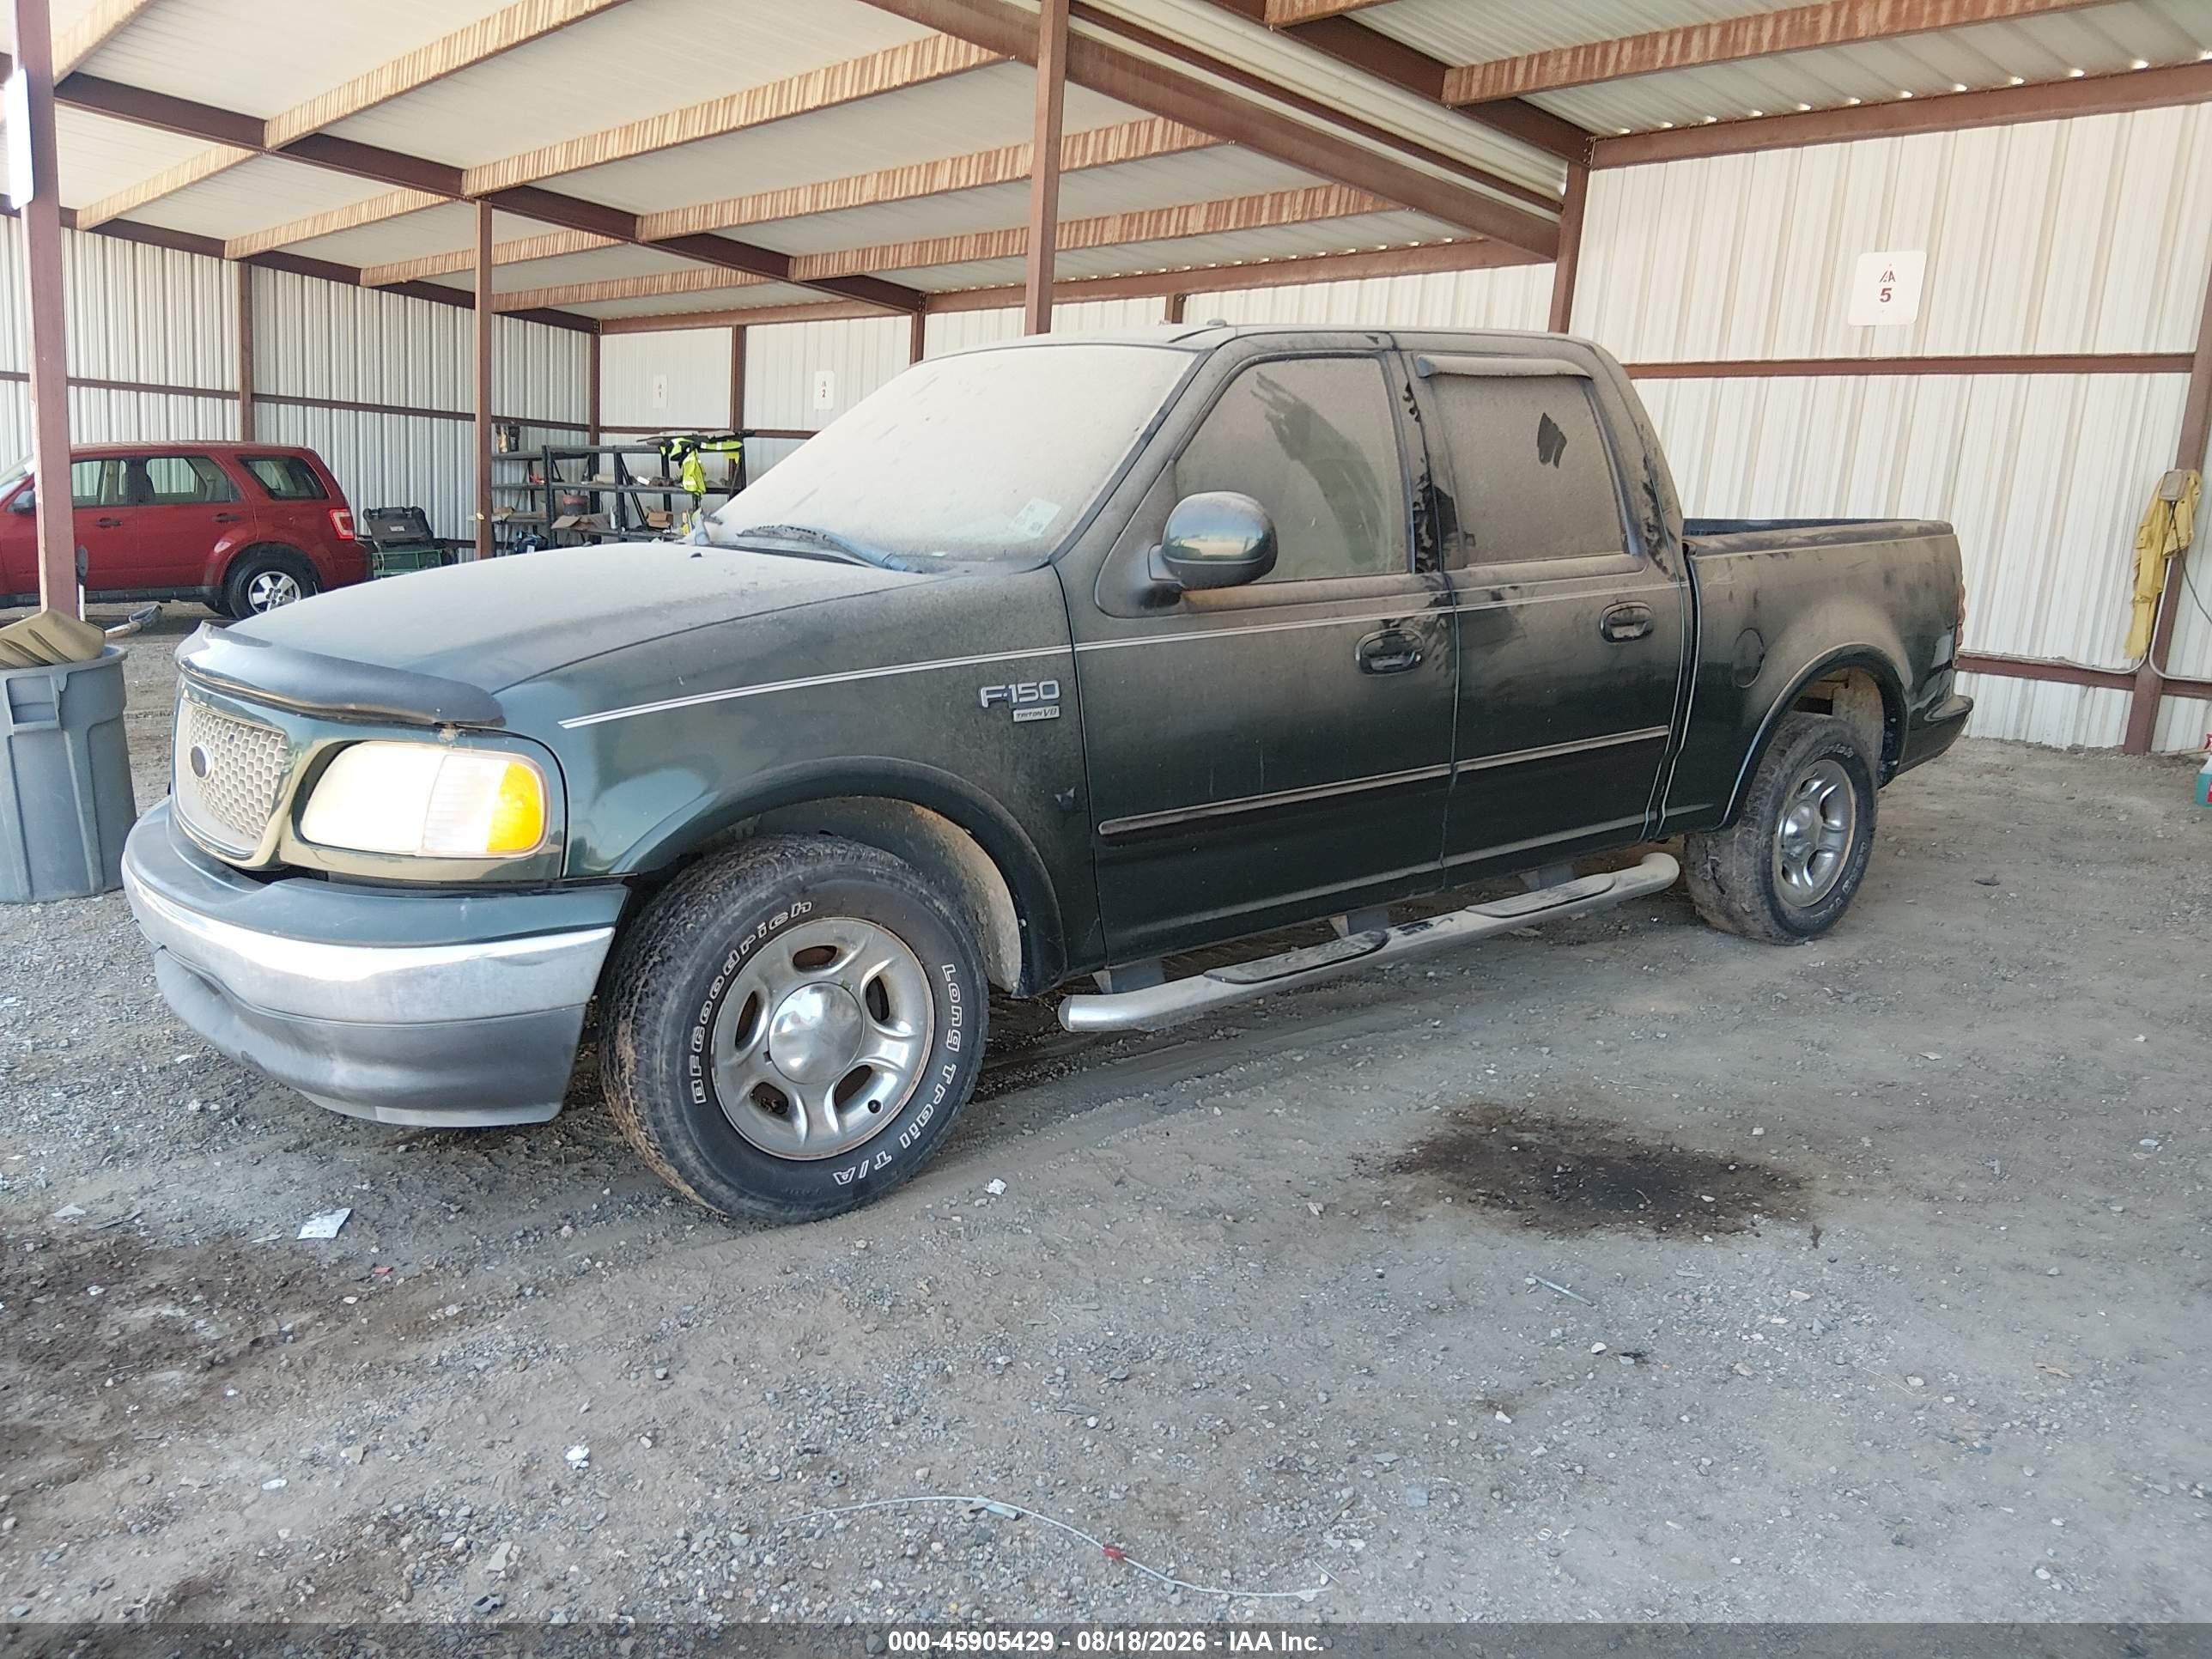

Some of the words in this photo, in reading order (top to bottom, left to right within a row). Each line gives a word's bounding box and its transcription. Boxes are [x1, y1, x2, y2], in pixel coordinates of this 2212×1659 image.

[1879, 287, 1893, 303] 5
[689, 900, 813, 1105] BFGoodrich
[941, 963, 963, 1053] Long
[899, 1063, 957, 1149] Trail
[832, 1150, 893, 1187] T/A
